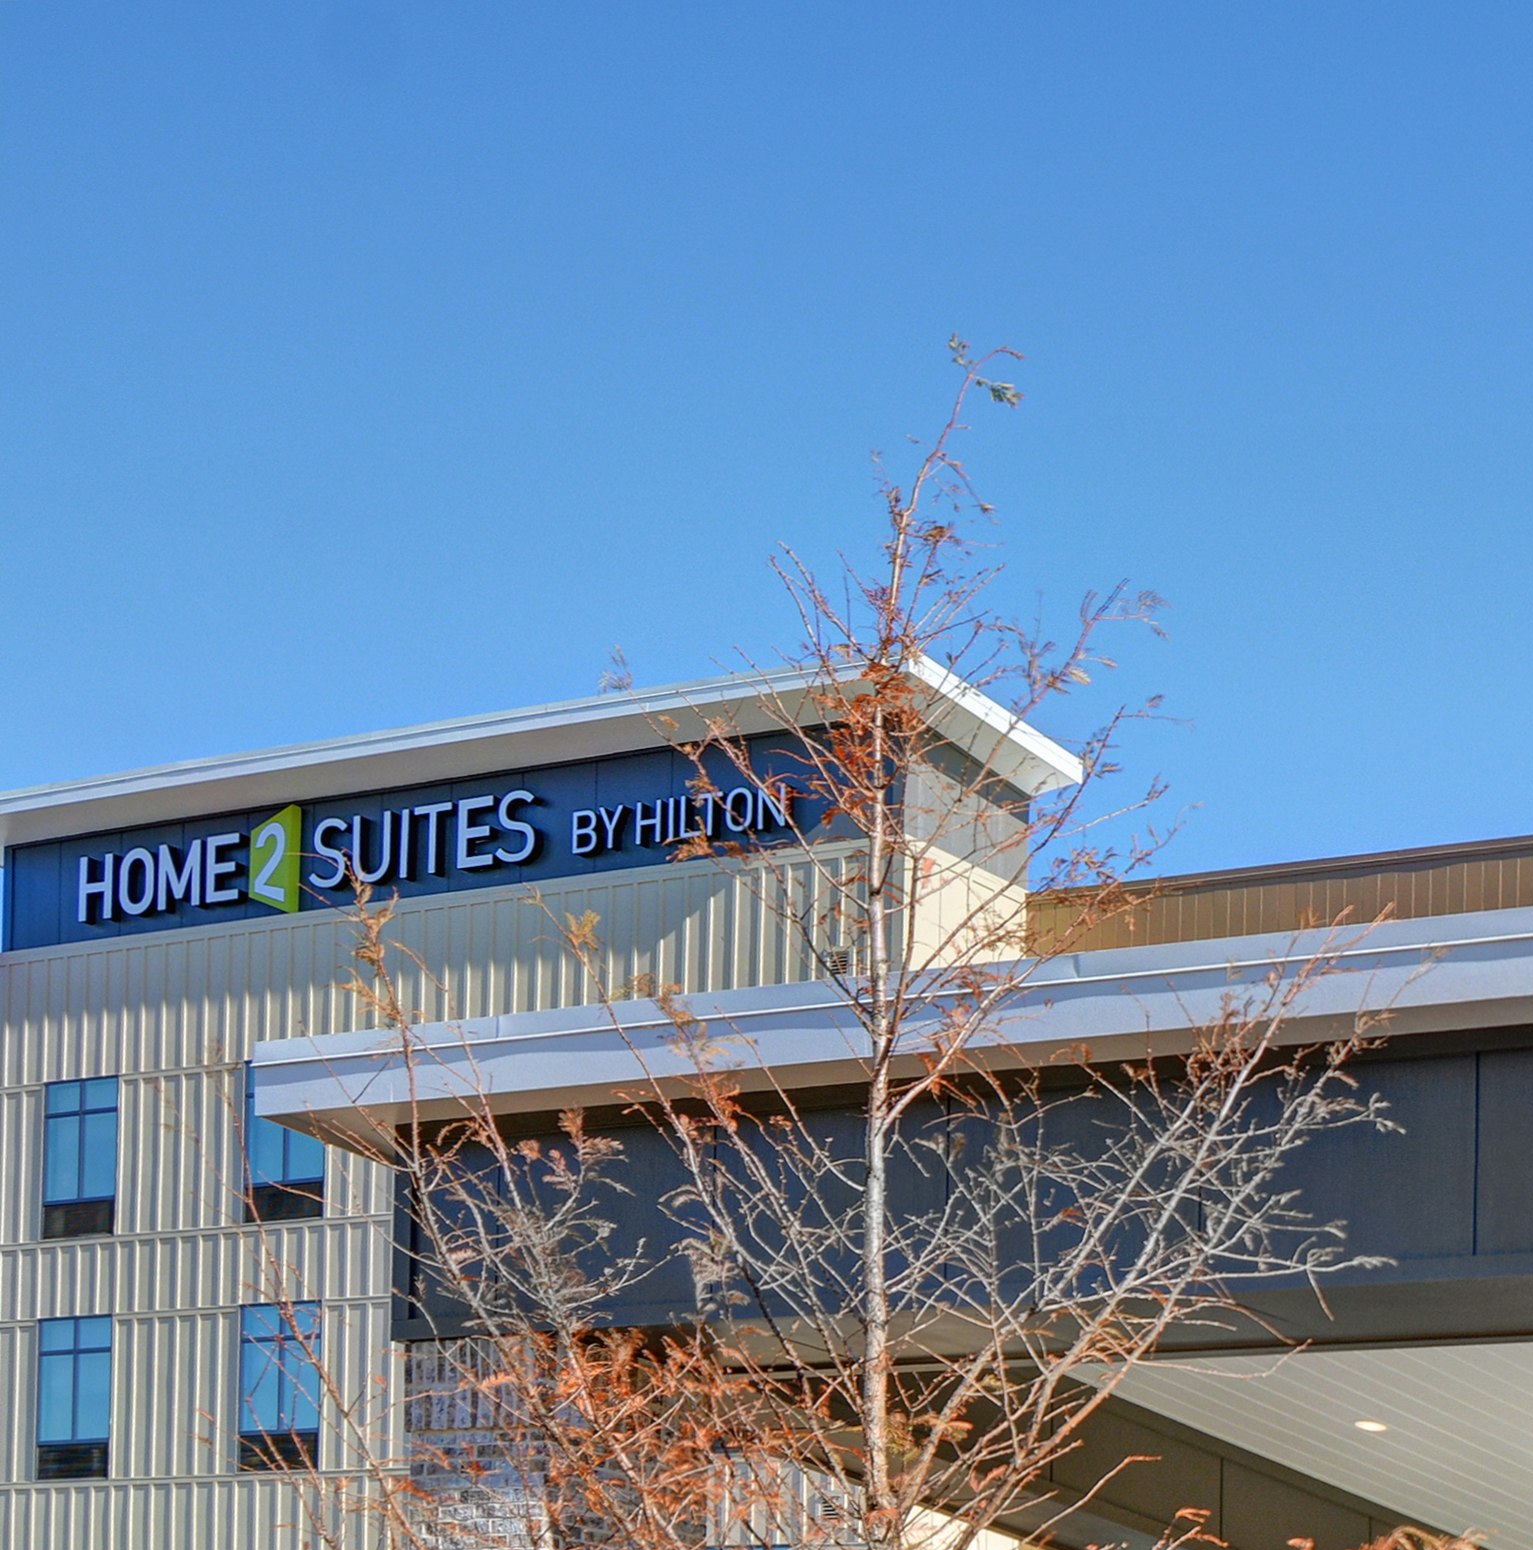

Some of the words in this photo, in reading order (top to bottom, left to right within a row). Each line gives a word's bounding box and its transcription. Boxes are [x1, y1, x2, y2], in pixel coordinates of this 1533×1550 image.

[78, 832, 241, 923] HOME
[253, 822, 287, 903] 2
[308, 789, 536, 889] SUITES
[571, 804, 624, 855] BY
[634, 782, 787, 846] HILTON
